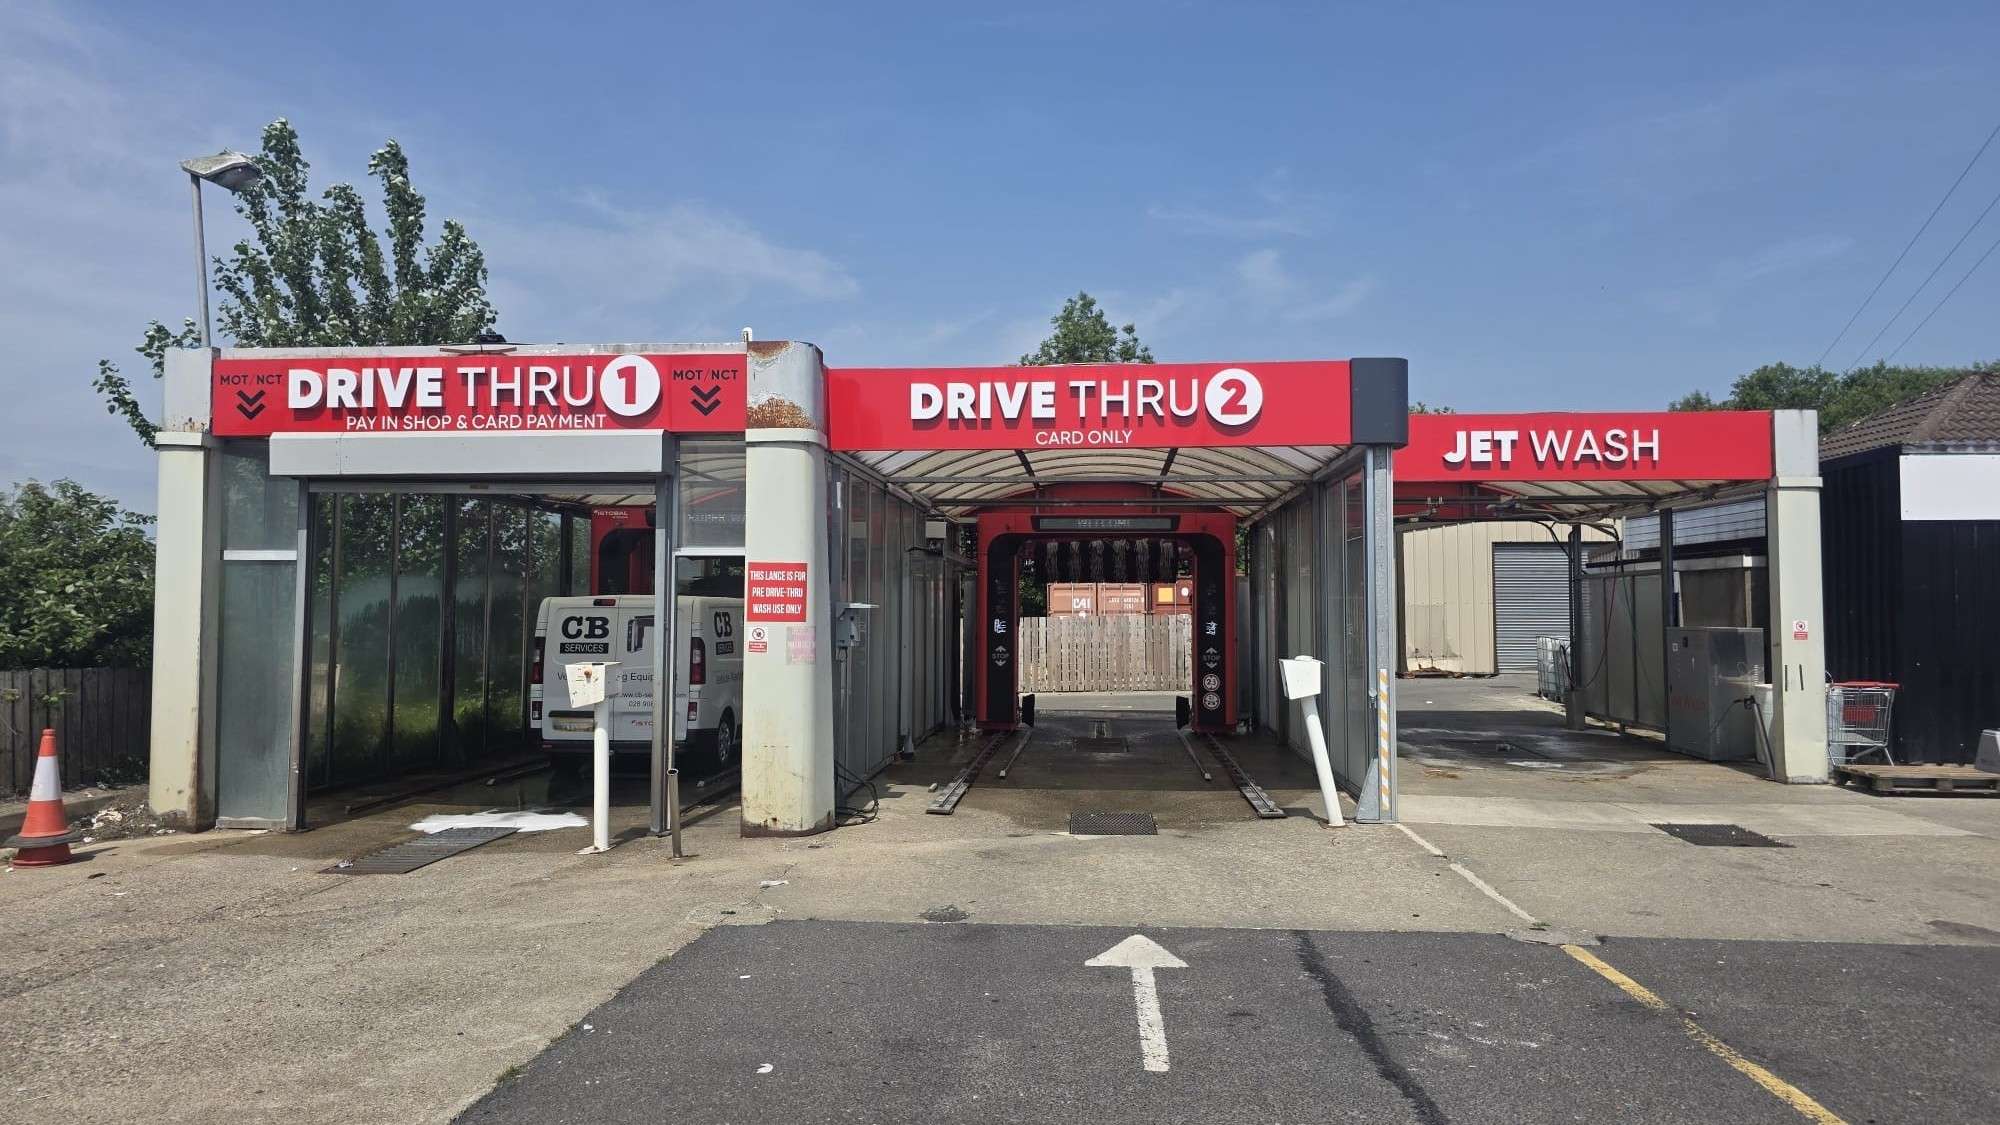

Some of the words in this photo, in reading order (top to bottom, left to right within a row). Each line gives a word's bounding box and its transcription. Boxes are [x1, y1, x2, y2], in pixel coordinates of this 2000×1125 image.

[672, 369, 739, 381] MOT/NCT
[287, 367, 443, 409] DRIVE
[457, 366, 593, 407] THRU
[616, 365, 637, 405] 1
[910, 381, 1056, 420] DRIVE
[1069, 378, 1199, 417] THRU
[1220, 378, 1248, 416] 2
[346, 416, 376, 430] PAY
[382, 416, 401, 429] IN
[403, 415, 451, 430] SHOP
[456, 415, 468, 429] &
[472, 414, 521, 429] CARD
[527, 413, 607, 429] PAYMENT
[1035, 430, 1083, 445] CARD
[1088, 429, 1132, 444] ONLY
[1442, 430, 1519, 463] JET
[1530, 429, 1660, 462] WASH
[750, 570, 765, 581] THIS
[765, 570, 786, 581] LANCE
[787, 571, 794, 581] IS
[794, 571, 806, 581] FOR
[752, 587, 766, 598] PRE
[766, 587, 803, 598] DRIVE-THRU
[752, 603, 772, 614] WASH
[772, 603, 785, 614] USE
[785, 603, 802, 614] ONLY
[561, 616, 610, 640] CB
[713, 611, 733, 638] CB
[564, 643, 605, 653] SERVICES
